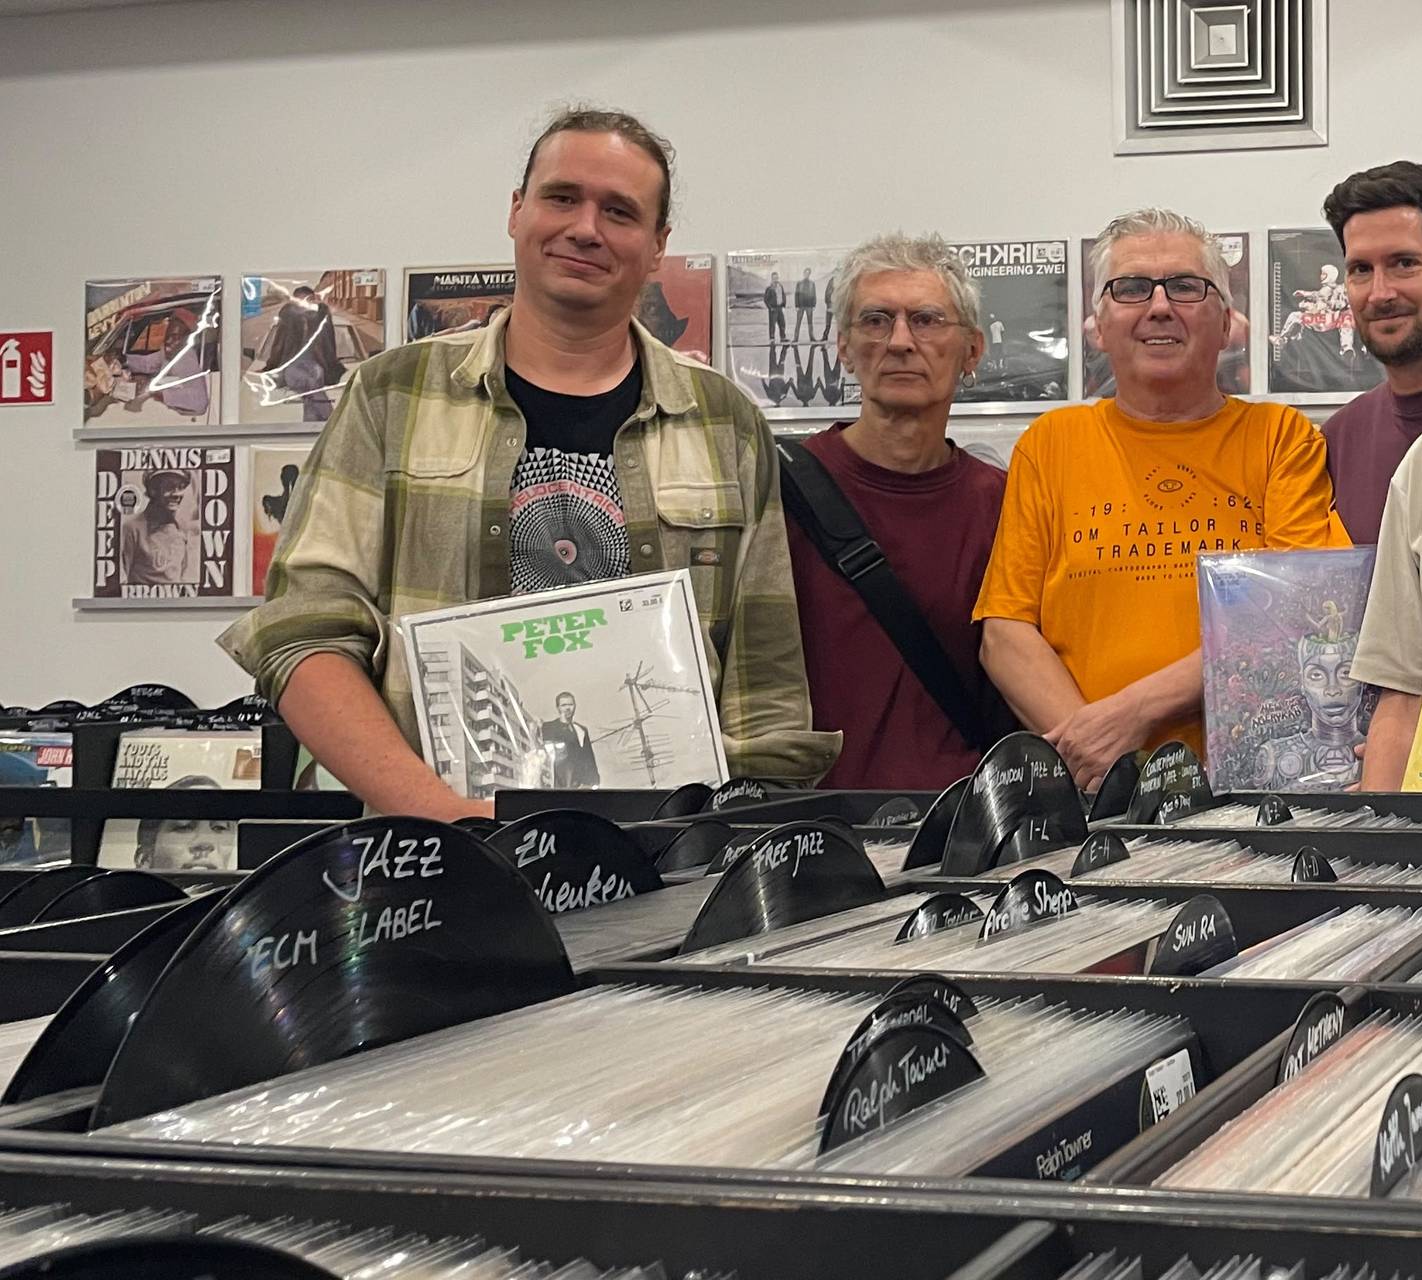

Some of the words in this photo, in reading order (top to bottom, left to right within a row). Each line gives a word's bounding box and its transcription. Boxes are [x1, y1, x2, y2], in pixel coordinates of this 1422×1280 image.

[964, 264, 1033, 277] NGINEERING
[1036, 264, 1065, 275] ZWEI
[120, 448, 202, 470] DENNIS
[96, 471, 119, 587] DEEP
[202, 468, 230, 589] DOWN
[1063, 528, 1099, 544] OM
[1123, 518, 1217, 536] TAILOR
[1096, 538, 1241, 561] TRADEMARK
[501, 607, 608, 642] PETER
[523, 630, 593, 659] FOX
[123, 743, 162, 756] TOOTS
[322, 829, 444, 902] JAZZ
[752, 839, 792, 873] FREE
[792, 831, 825, 878] JAZZ
[1023, 880, 1077, 921] Shepp
[250, 929, 318, 971] ECM
[358, 899, 442, 947] LABEL
[1172, 920, 1197, 952] SUN
[1200, 913, 1217, 941] RA
[1306, 1004, 1346, 1063] METHENY
[843, 1062, 900, 1133] Ralph
[1036, 1145, 1067, 1181] Ralph
[1061, 1128, 1093, 1166] Towner
